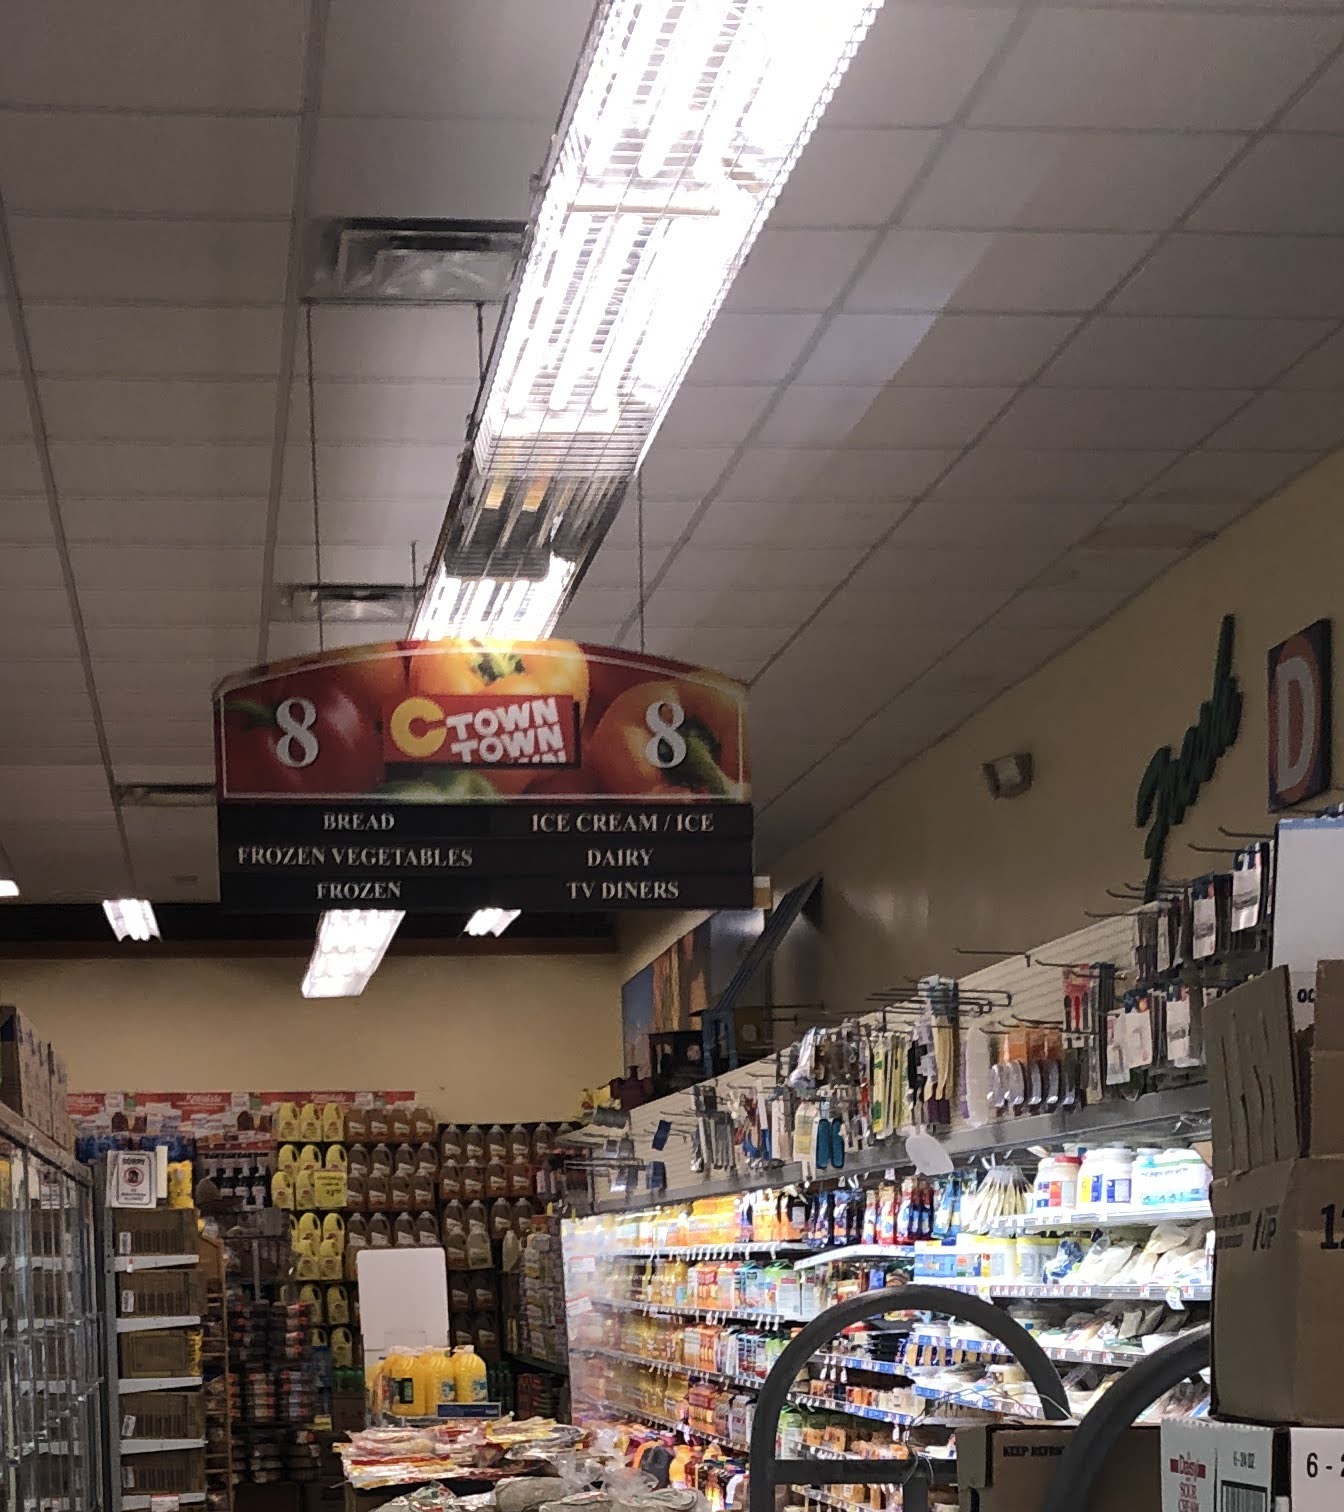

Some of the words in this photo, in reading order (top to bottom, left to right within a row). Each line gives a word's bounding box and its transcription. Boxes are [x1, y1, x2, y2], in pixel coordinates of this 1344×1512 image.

[274, 697, 320, 768] 8
[445, 698, 559, 744] TOWN
[643, 701, 687, 770] 8
[450, 725, 565, 765] TOWN
[323, 812, 396, 832] BREAD
[531, 814, 571, 833] ICE
[576, 814, 658, 833] CREAM
[662, 814, 671, 832] /
[676, 814, 714, 832] ICE
[237, 846, 327, 867] FROZEN
[332, 846, 473, 868] VEGETABLES
[586, 848, 655, 868] DAIRY
[316, 881, 402, 900] FROZEN
[566, 881, 598, 901] TV
[601, 880, 680, 901] DINERS
[1177, 1453, 1200, 1479] Daisy
[1305, 1452, 1319, 1479] 6
[1179, 1481, 1198, 1501] SOUR
